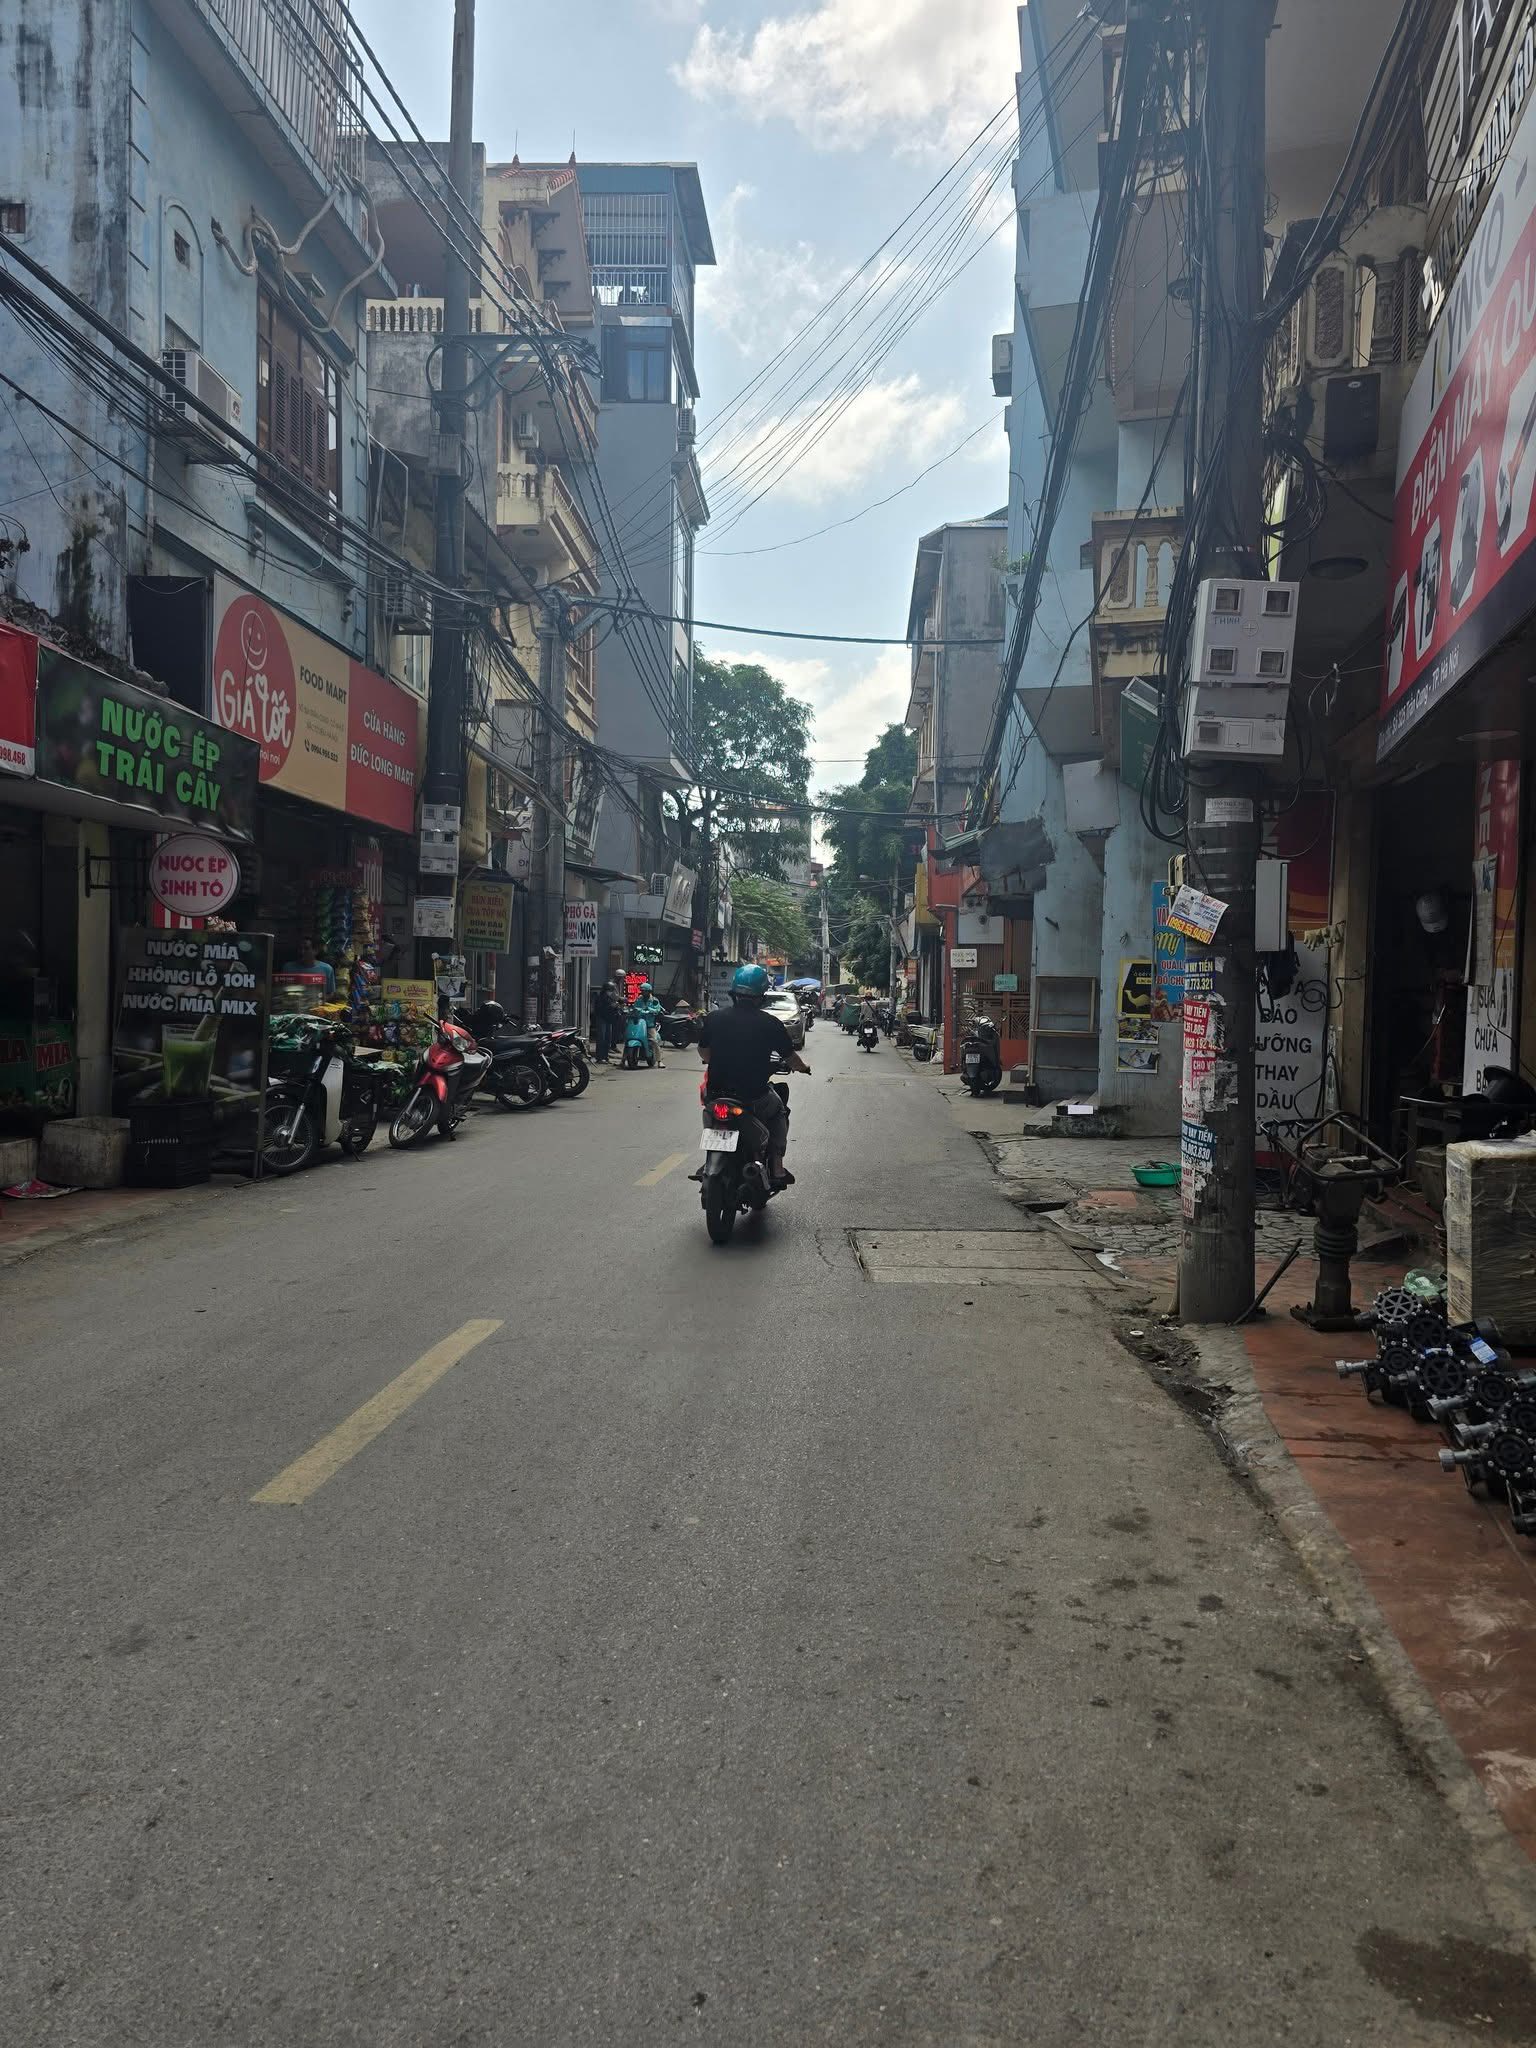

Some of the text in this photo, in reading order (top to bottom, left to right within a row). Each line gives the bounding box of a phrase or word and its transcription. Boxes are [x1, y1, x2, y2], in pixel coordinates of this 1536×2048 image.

[300, 665, 347, 705] FOOD MART
[101, 698, 221, 772] NƯỚC ÉP
[363, 708, 381, 736] CỬA
[383, 720, 406, 747] HÀNG
[96, 739, 221, 812] TRÁI CÂY
[350, 743, 415, 787] ĐỨC LONG MART
[158, 855, 228, 873] NƯỚC ÉP
[160, 879, 224, 897] SINH TỐ
[583, 903, 596, 919] GÀ
[580, 921, 596, 942] MỌC
[146, 939, 239, 960] NƯỚC MÍA
[127, 961, 191, 985] KHỔNG
[195, 967, 218, 987] LỒ
[223, 972, 256, 989] 10K
[123, 993, 258, 1016] NƯỚC MÍA MIX
[1474, 1027, 1498, 1053] CHỮA
[1255, 1065, 1300, 1082] THAY
[1256, 1087, 1294, 1111] DẦU
